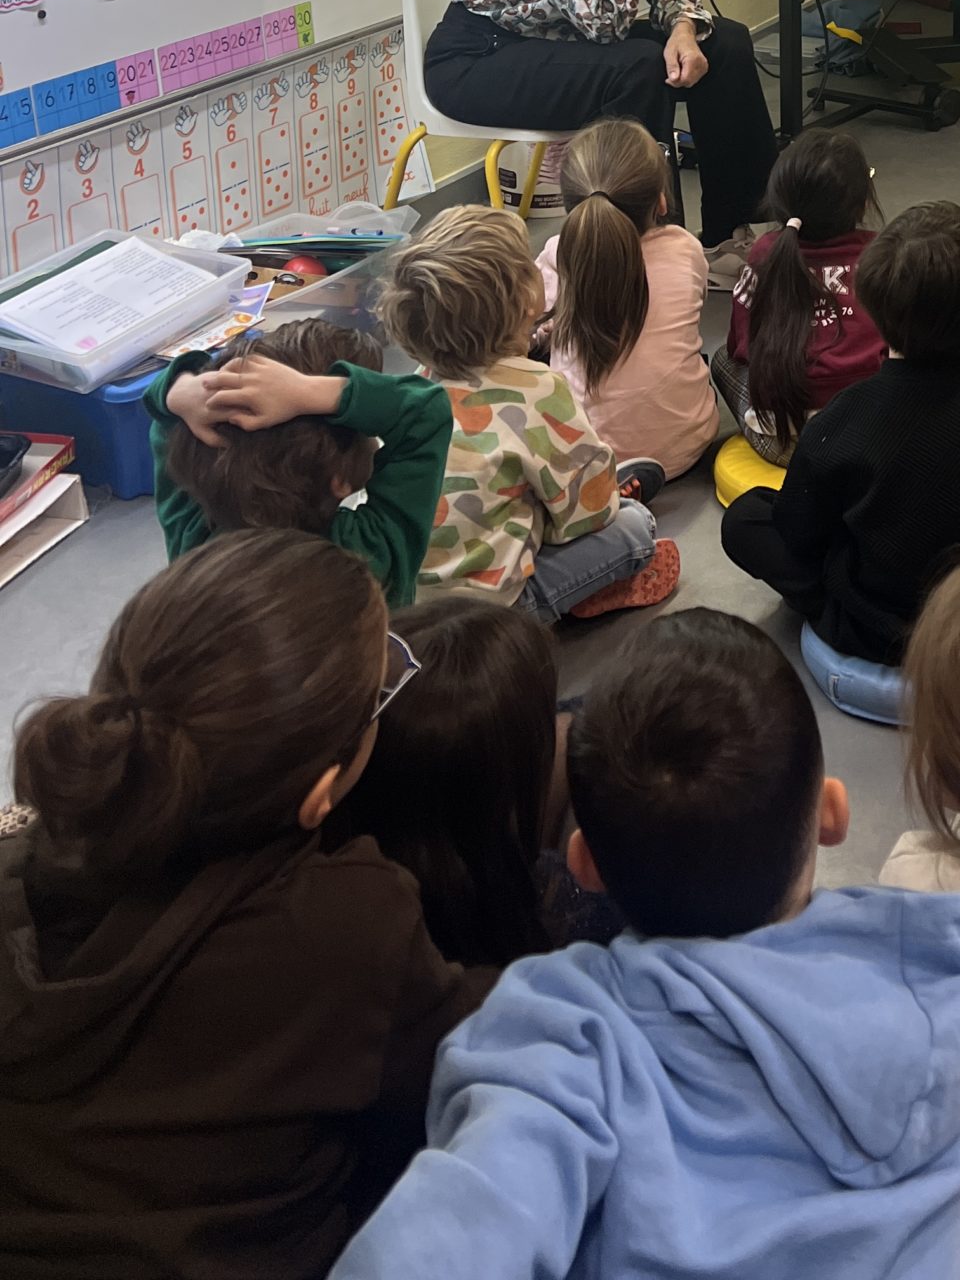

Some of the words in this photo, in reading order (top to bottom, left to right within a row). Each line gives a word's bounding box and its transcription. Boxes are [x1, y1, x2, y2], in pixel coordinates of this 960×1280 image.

[119, 65, 136, 84] 20
[138, 59, 155, 78] 21
[161, 52, 177, 71] 22
[179, 47, 195, 65] 23
[196, 41, 212, 60] 24
[214, 36, 229, 54] 25
[230, 32, 246, 49] 26
[247, 26, 261, 44] 27
[265, 20, 280, 38] 28
[282, 15, 296, 32] 29
[297, 10, 311, 27] 30
[380, 63, 394, 81] 10
[347, 78, 356, 95] 9
[309, 93, 318, 110] 8
[268, 107, 279, 126] 7
[226, 124, 236, 142] 6
[181, 141, 192, 160] 5
[134, 159, 145, 178] 4
[82, 178, 93, 198] 3
[27, 198, 40, 220] 2
[842, 306, 853, 316] 76
